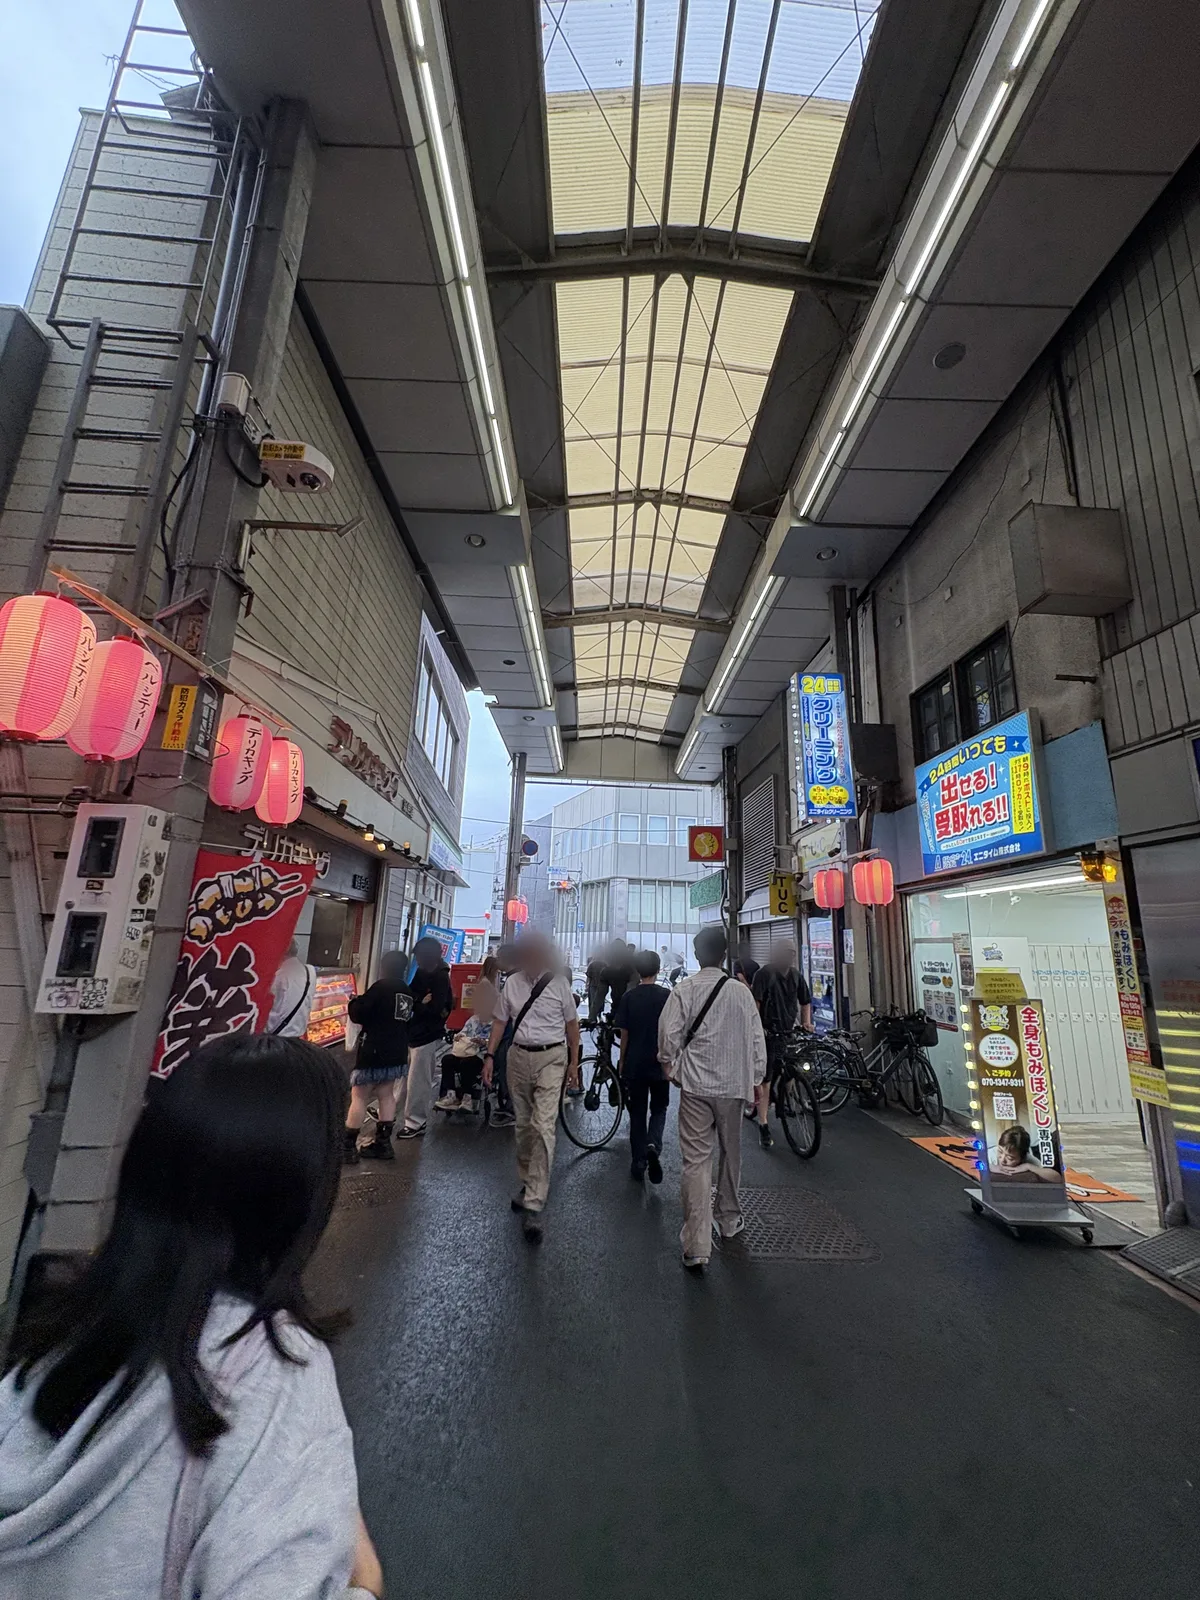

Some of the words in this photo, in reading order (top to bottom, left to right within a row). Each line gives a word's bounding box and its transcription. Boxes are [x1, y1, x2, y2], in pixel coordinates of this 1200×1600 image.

[237, 728, 262, 785] デリカキング
[812, 696, 837, 784] クリーニング
[289, 749, 301, 804] デリカキング
[776, 876, 789, 914] TUC
[1119, 929, 1137, 990] もみほぐし
